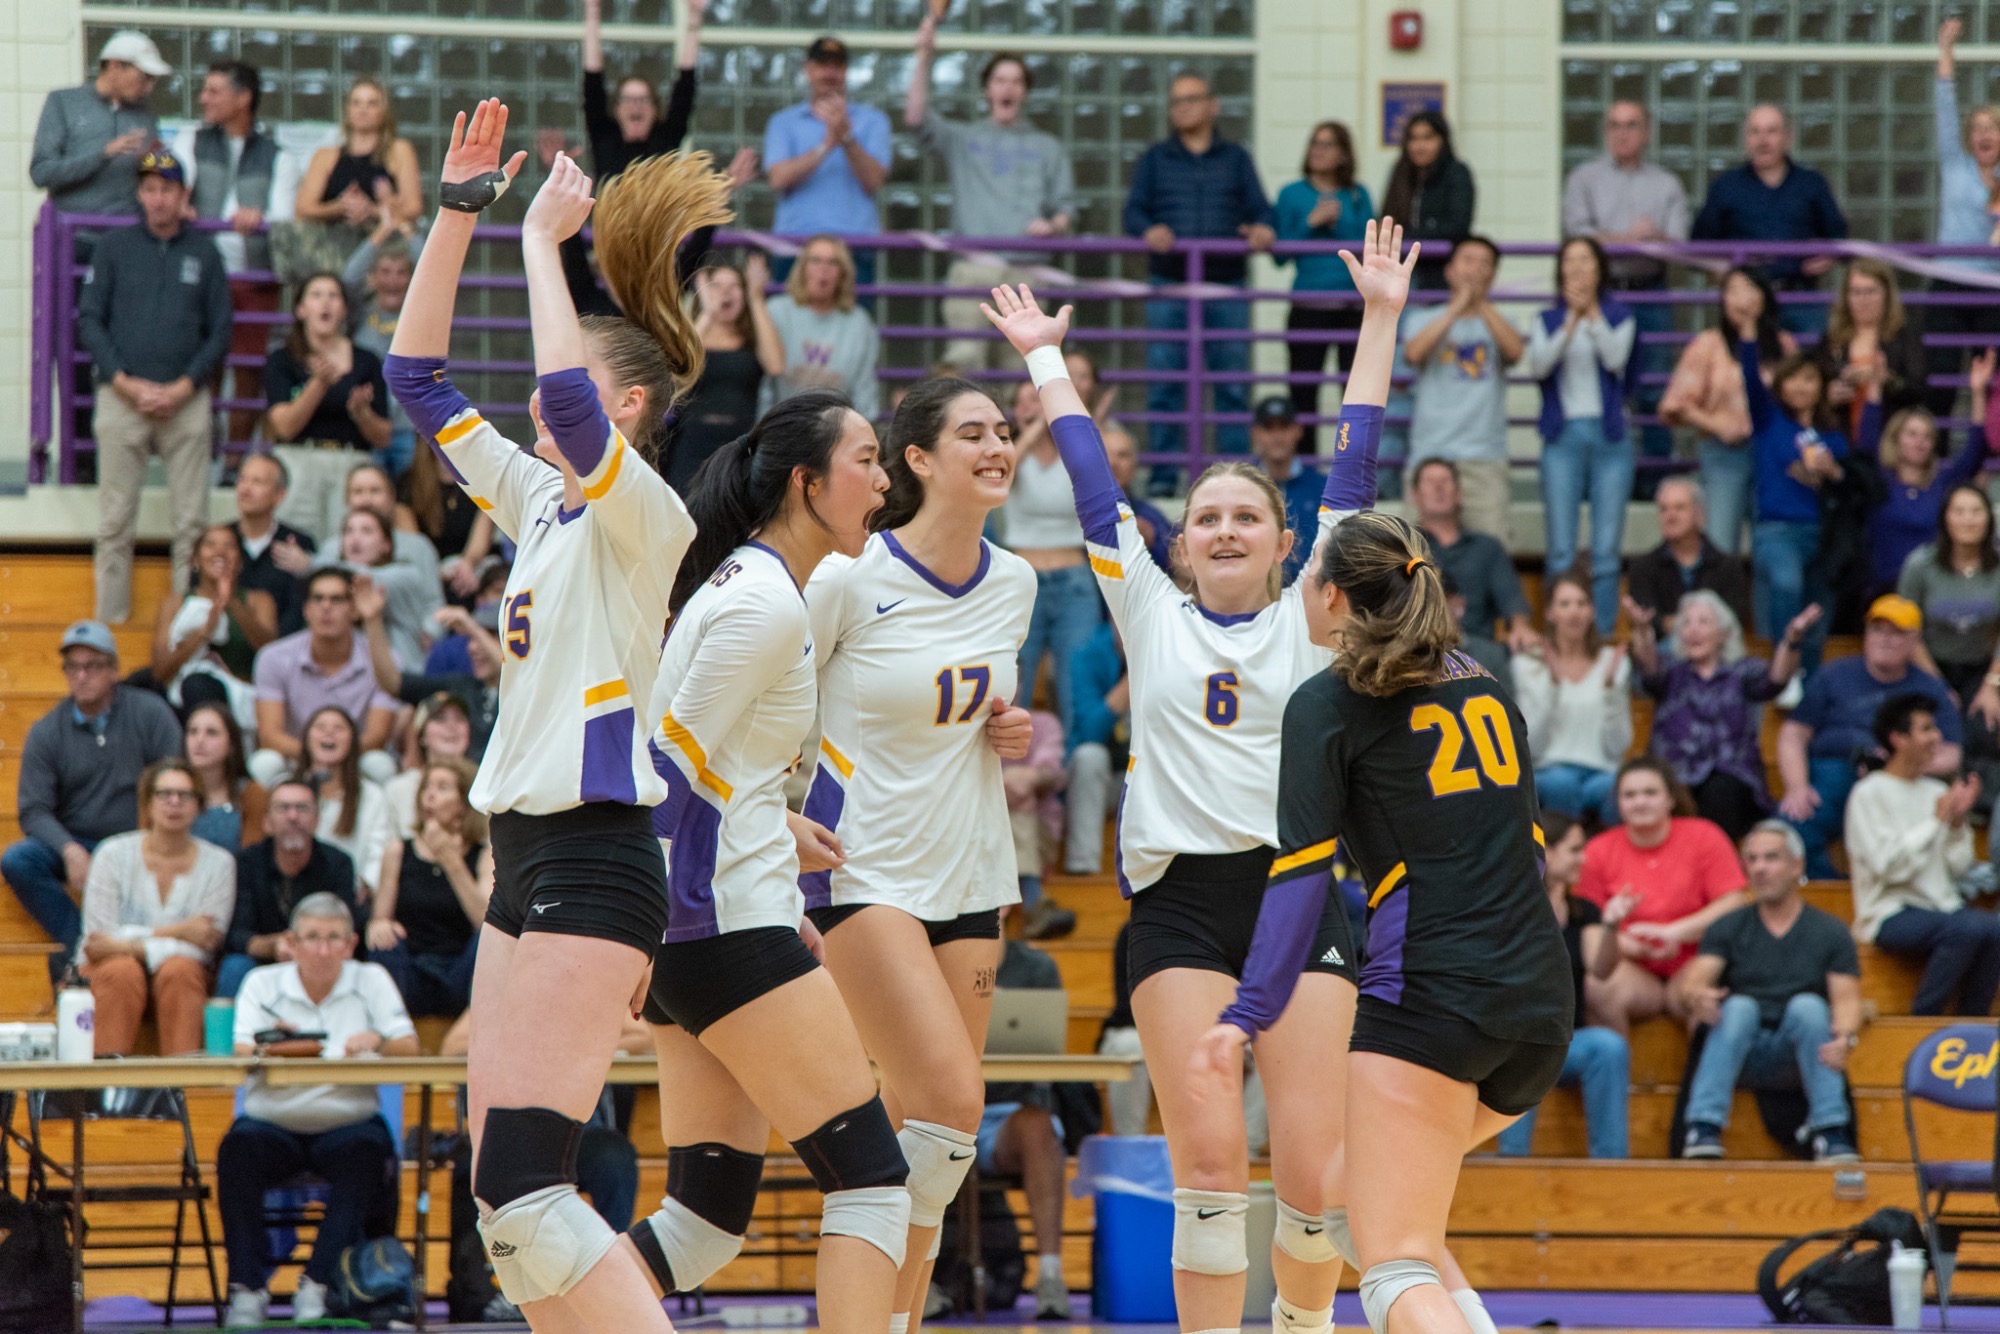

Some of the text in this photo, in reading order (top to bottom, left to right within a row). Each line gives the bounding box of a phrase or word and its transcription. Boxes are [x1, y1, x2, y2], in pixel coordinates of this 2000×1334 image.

[933, 662, 993, 727] 17
[1203, 669, 1241, 729] 6
[1408, 693, 1521, 799] 20
